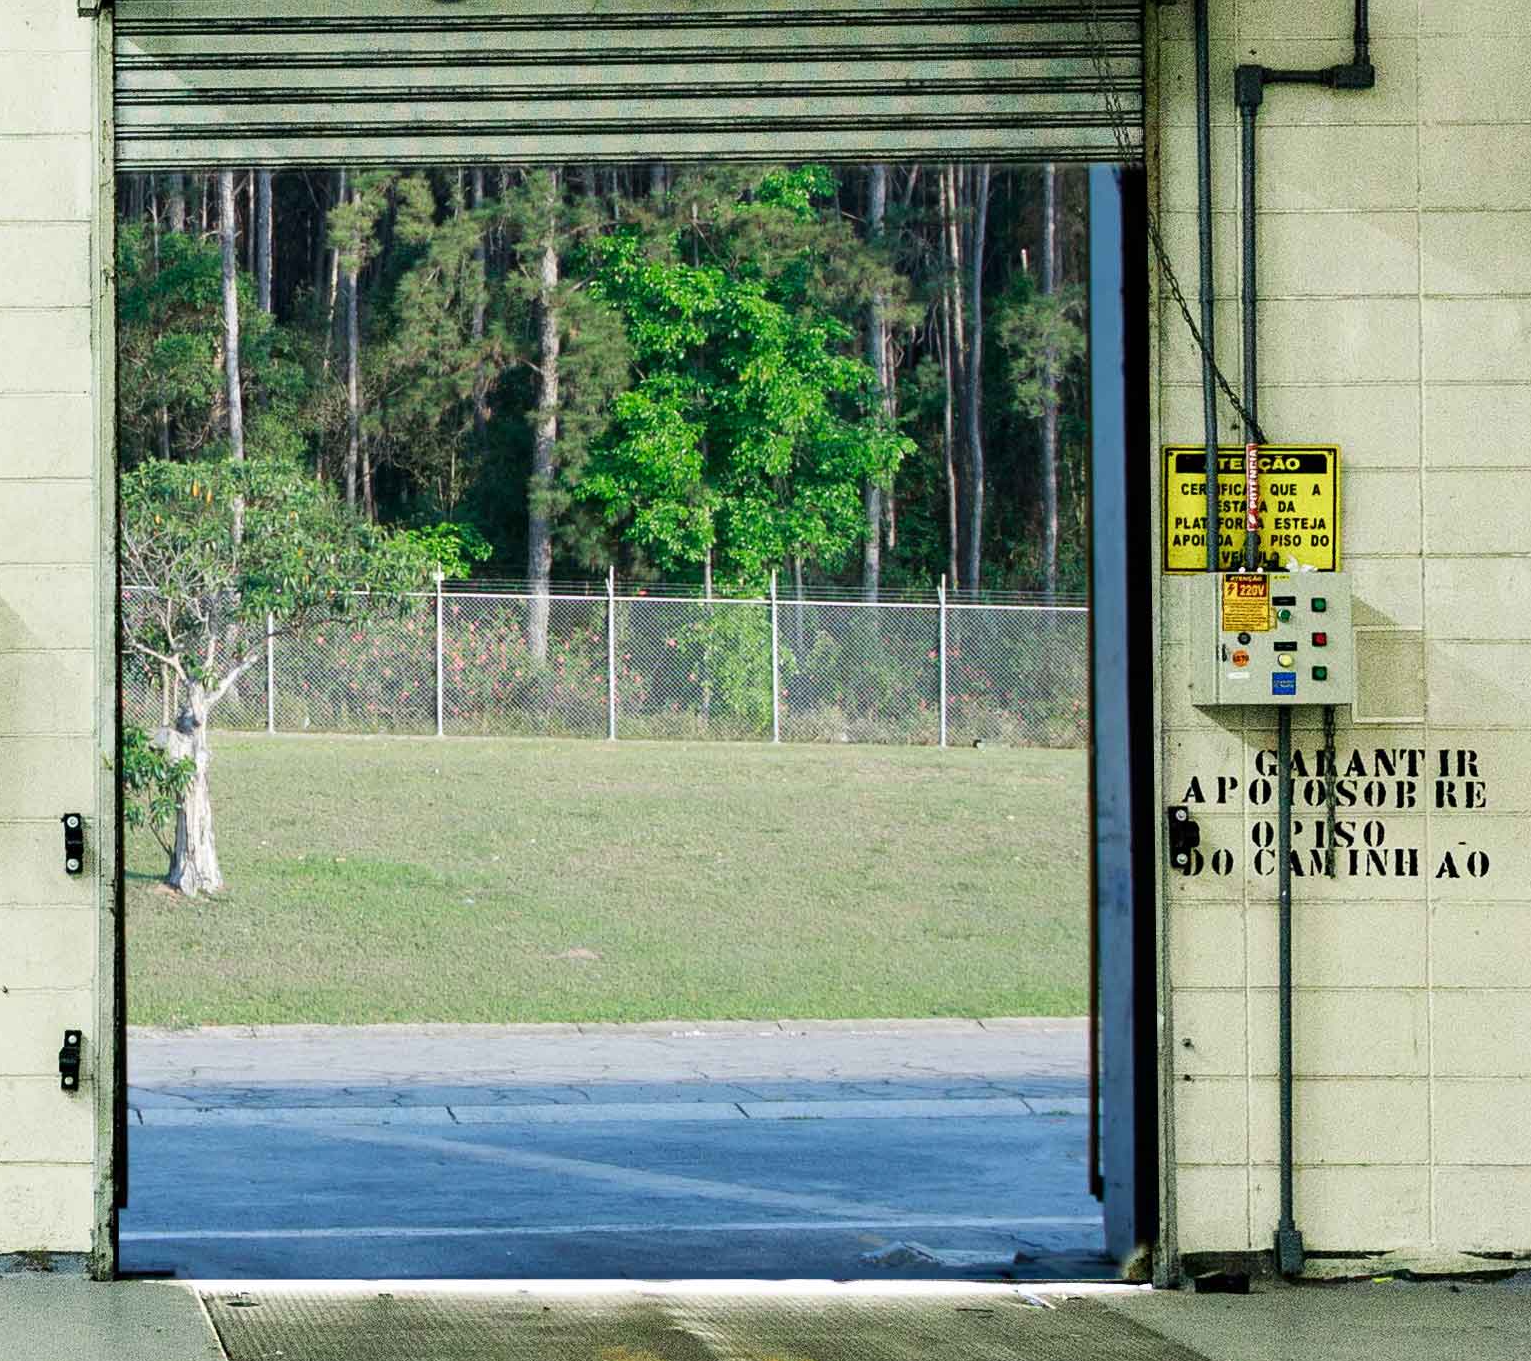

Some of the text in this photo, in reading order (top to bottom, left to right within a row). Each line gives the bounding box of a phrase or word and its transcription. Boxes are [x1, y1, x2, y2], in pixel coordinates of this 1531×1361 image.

[1204, 456, 1301, 472] TEÇÃO
[1270, 483, 1297, 497] QUE
[1312, 484, 1321, 496] A
[1277, 500, 1296, 513] DA
[1274, 516, 1327, 530] ESTEJA
[1173, 534, 1234, 547] APOIDA
[1270, 534, 1302, 547] PISO
[1310, 534, 1330, 547] DO
[1240, 584, 1265, 596] 220V
